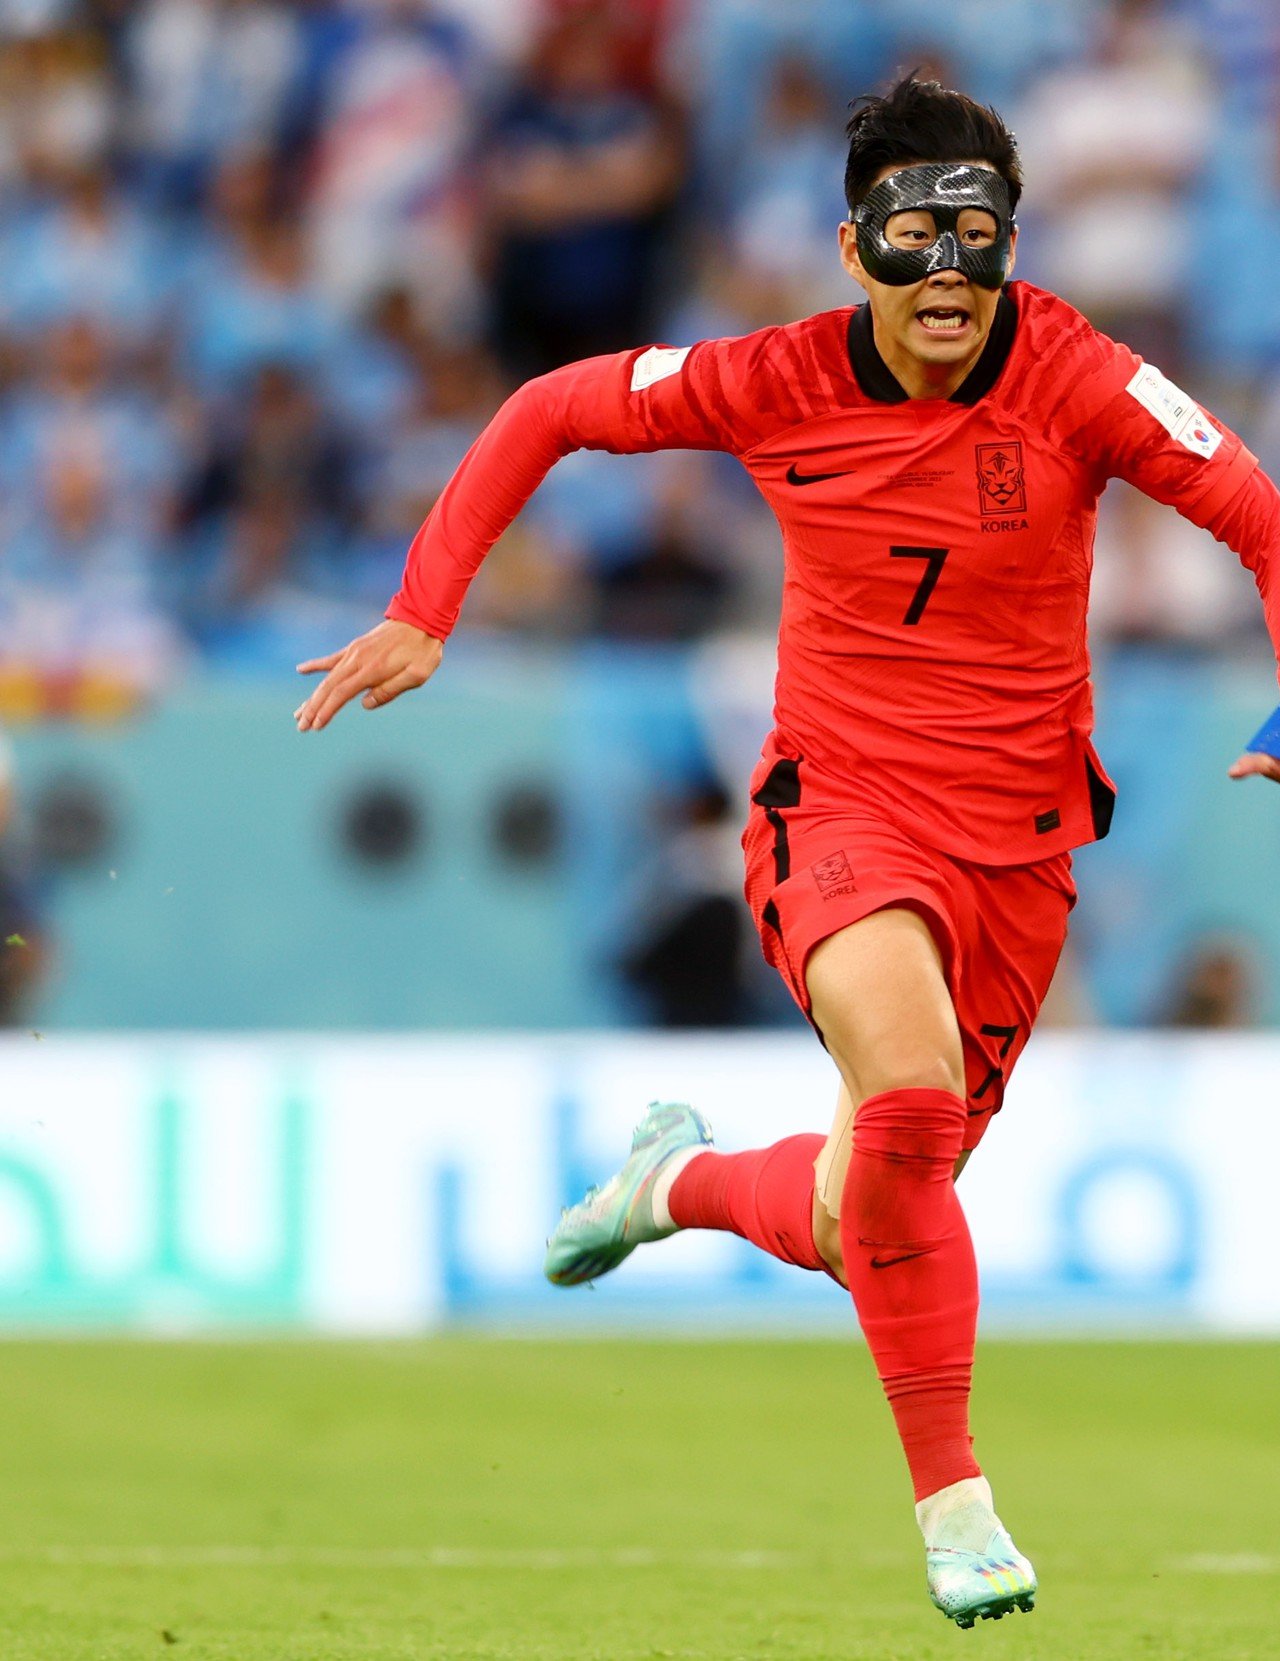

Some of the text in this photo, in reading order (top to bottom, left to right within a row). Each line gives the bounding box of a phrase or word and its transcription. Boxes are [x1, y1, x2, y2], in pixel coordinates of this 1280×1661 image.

[980, 519, 1029, 533] KOREA
[889, 545, 950, 626] 7
[822, 885, 858, 902] KOREA
[971, 1023, 1021, 1099] 7
